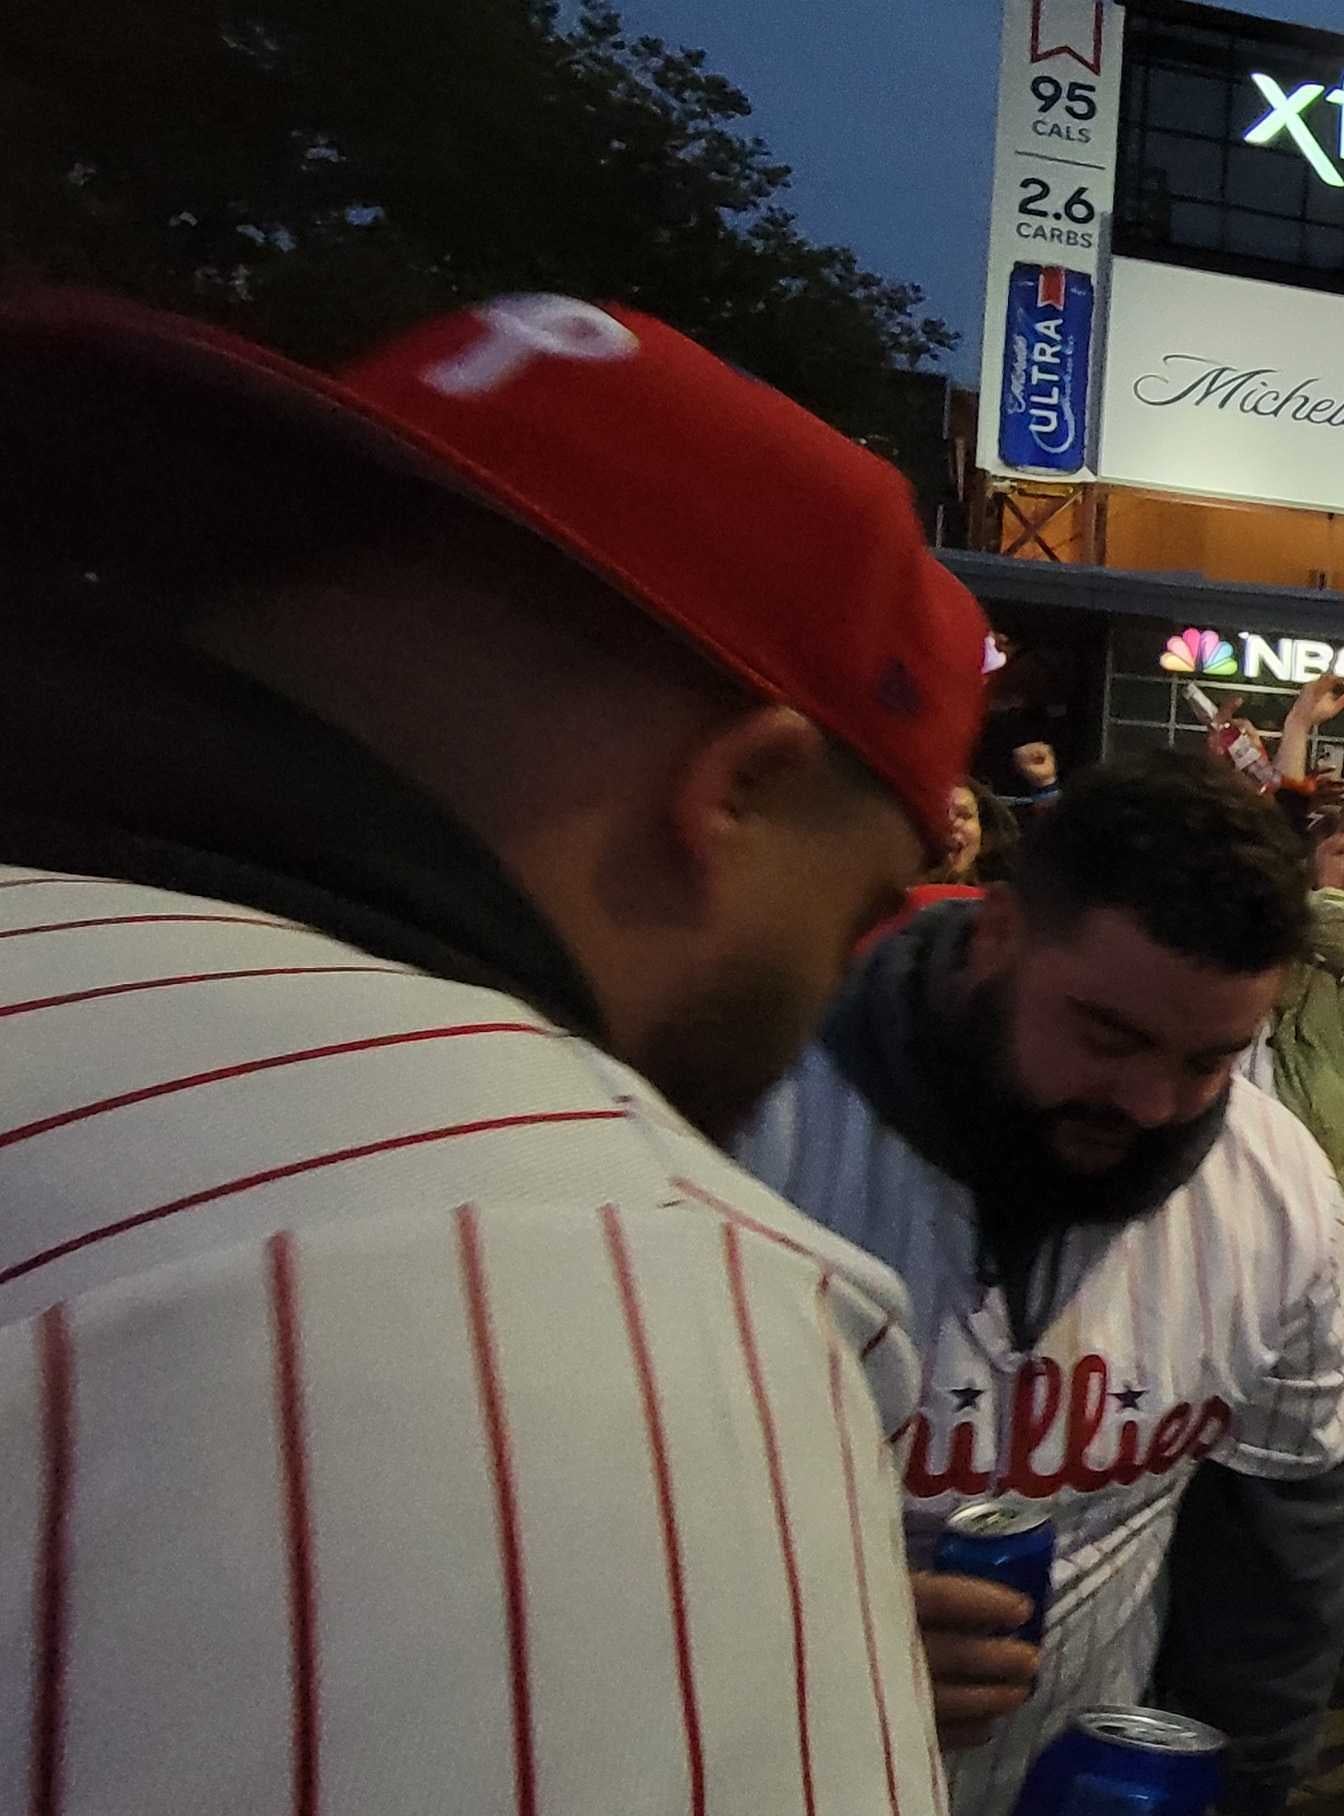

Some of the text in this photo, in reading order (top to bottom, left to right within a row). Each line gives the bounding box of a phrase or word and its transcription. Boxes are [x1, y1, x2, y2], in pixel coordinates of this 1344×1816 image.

[1030, 75, 1097, 121] 95
[1032, 120, 1092, 143] CALS
[1018, 177, 1095, 224] 2.6
[1016, 222, 1093, 248] CARBS
[418, 291, 641, 398] P
[1028, 317, 1064, 433] ULTRA
